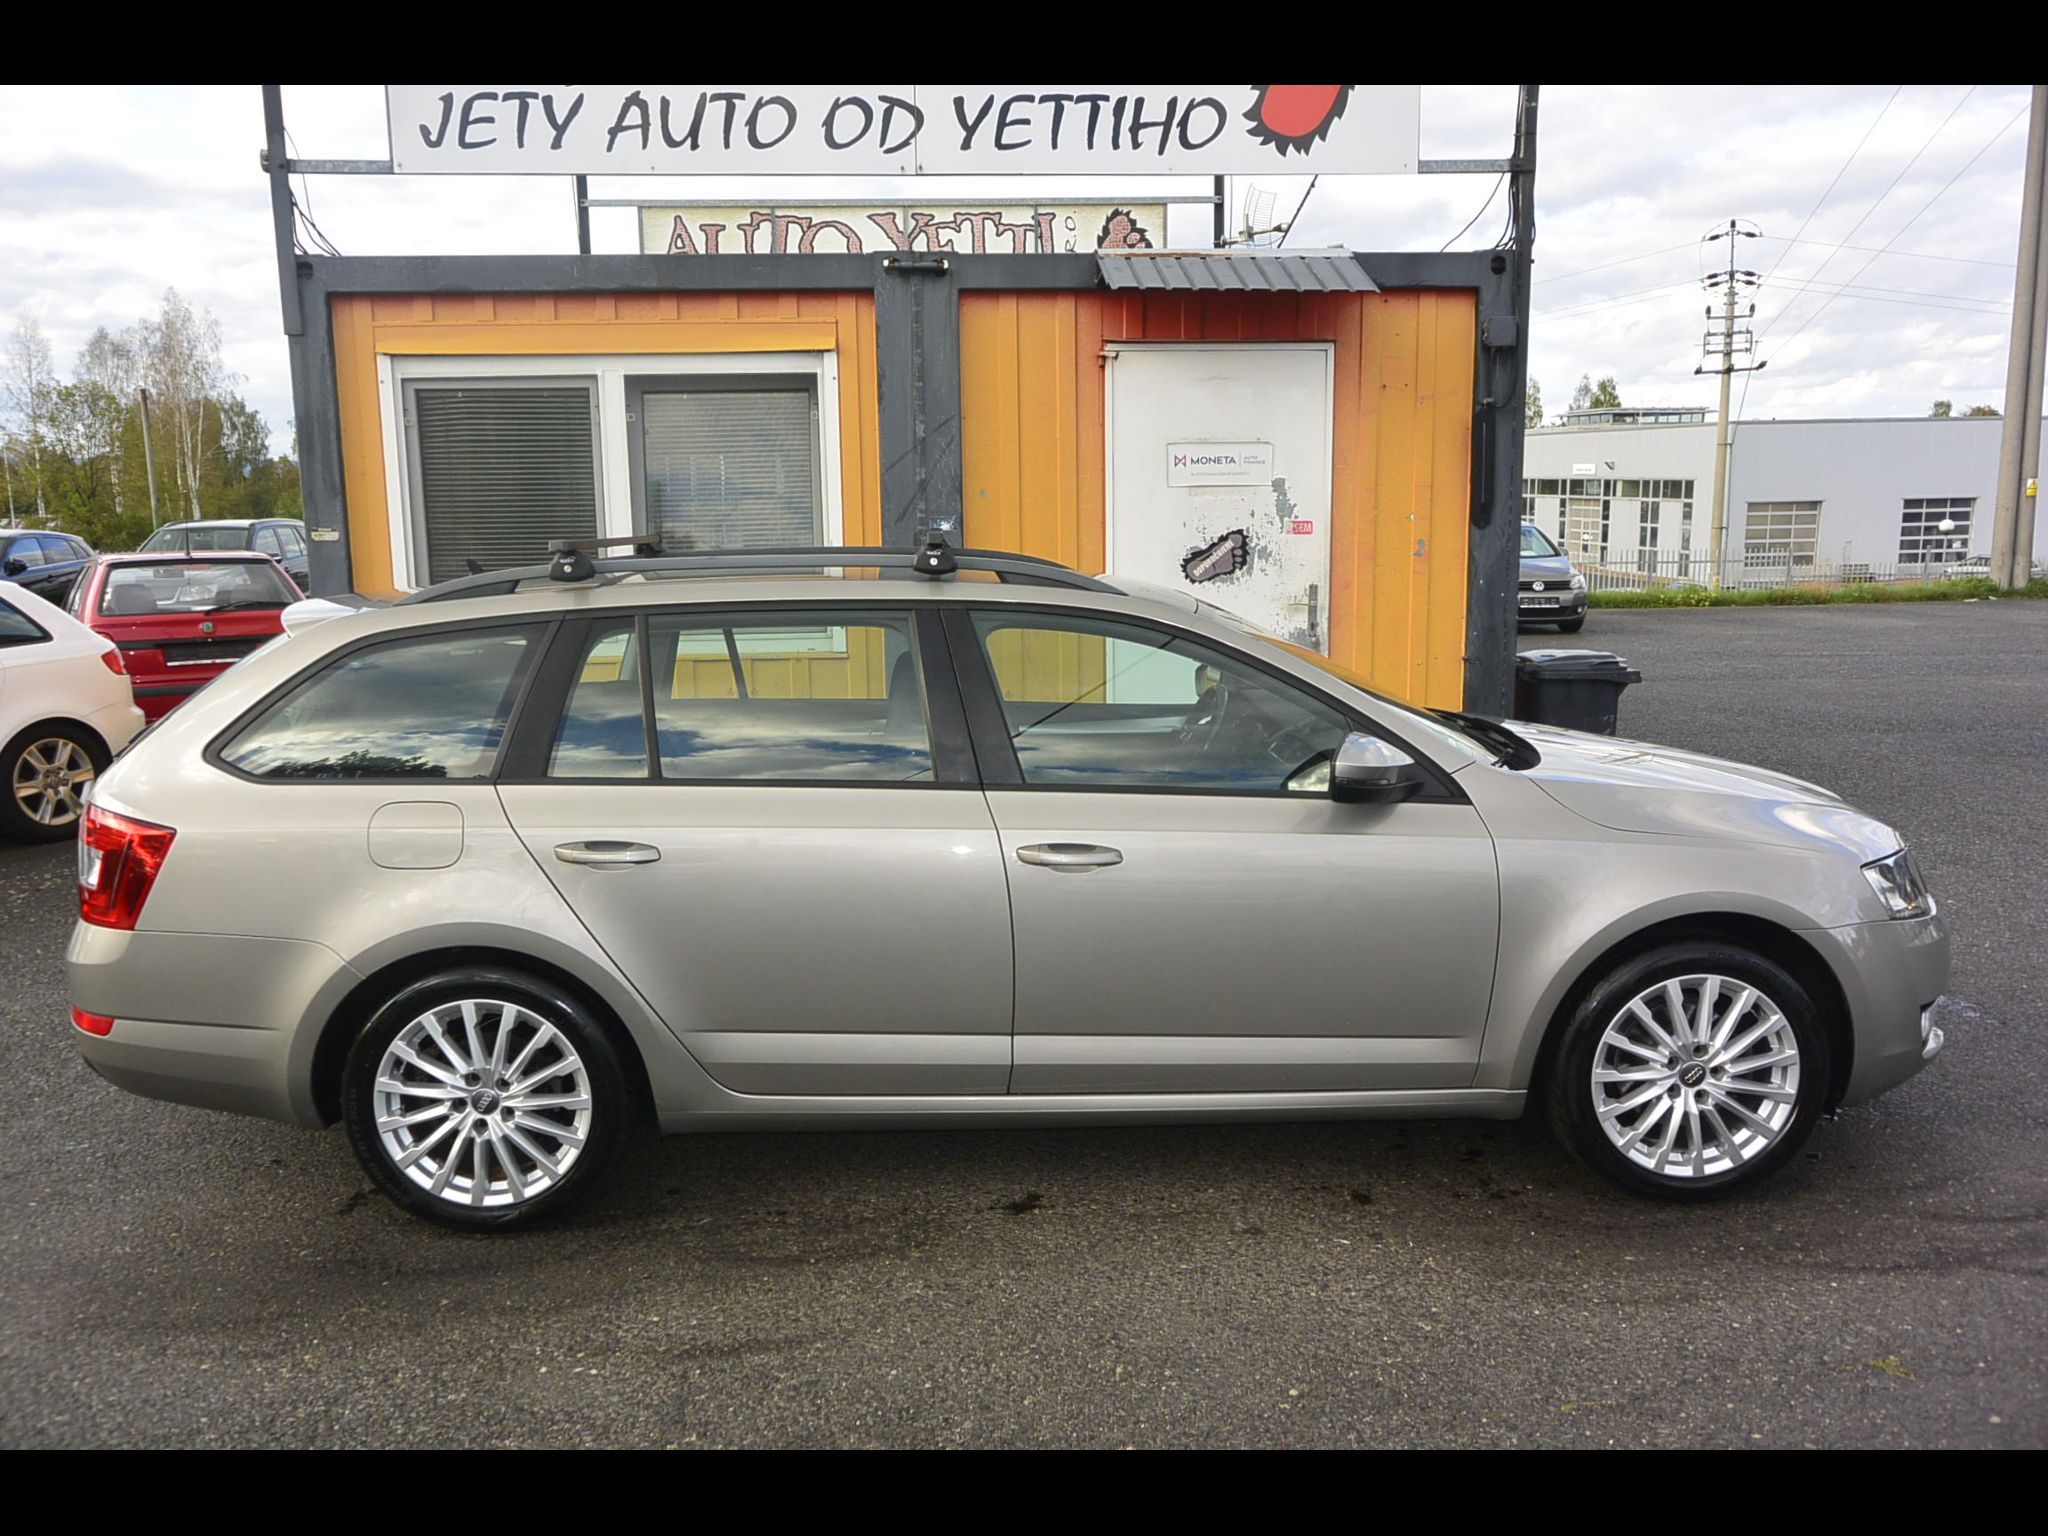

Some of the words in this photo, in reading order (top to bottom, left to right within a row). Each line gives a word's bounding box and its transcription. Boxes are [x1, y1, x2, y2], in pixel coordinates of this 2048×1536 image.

[419, 92, 584, 150] JETY
[606, 91, 798, 153] AUTO
[821, 95, 925, 155] OD
[952, 94, 1228, 156] YETTIHO
[1190, 456, 1237, 465] MONETA
